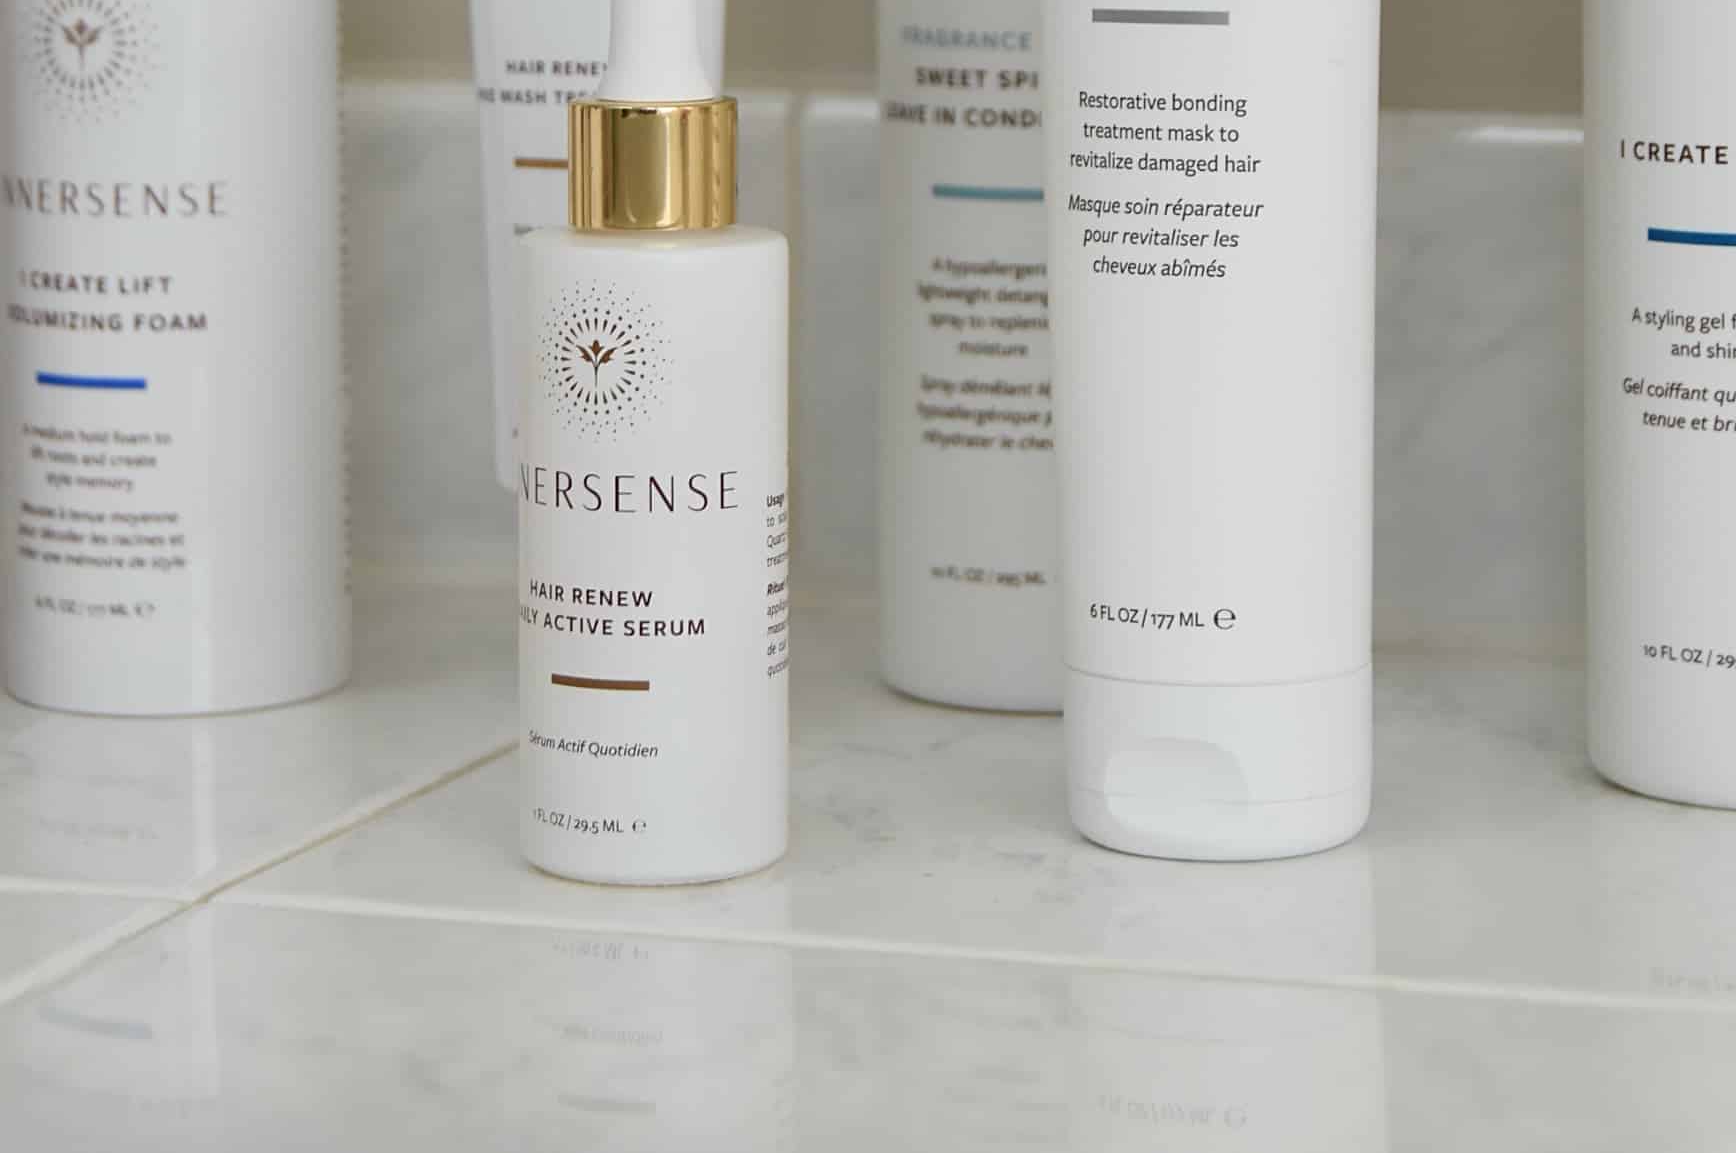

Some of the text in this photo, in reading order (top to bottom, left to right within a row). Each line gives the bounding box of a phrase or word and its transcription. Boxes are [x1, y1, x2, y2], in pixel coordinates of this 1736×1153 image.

[505, 59, 545, 76] HAIR
[915, 66, 987, 89] SWEET
[501, 89, 546, 104] WASH
[1079, 91, 1248, 118] Restorative bonding
[935, 106, 956, 125] IN
[1083, 122, 1240, 143] treatment mask to
[1069, 150, 1262, 177] revitalize damaged hair
[1619, 139, 1729, 165] I CREATE
[1068, 194, 1265, 222] Masque soin réparateur
[1083, 227, 1240, 248] pour revitaliser les
[1092, 255, 1227, 278] cheveux abîmés
[29, 270, 108, 295] CREATE
[118, 275, 172, 296] LIFT
[132, 310, 208, 332] FOAM
[1631, 306, 1641, 324] A
[1645, 310, 1696, 334] styling
[1699, 312, 1726, 335] gel
[1671, 341, 1702, 359] and
[1622, 377, 1645, 395] Gel
[1646, 382, 1708, 402] coiffant
[1643, 411, 1687, 430] tenue
[1691, 415, 1707, 431] et
[530, 577, 654, 608] HAIR RENEW
[543, 612, 614, 636] ACTIVE
[623, 618, 706, 637] SERUM
[1089, 603, 1098, 619] 6
[1100, 604, 1116, 622] FL
[1117, 607, 1139, 624] OZ
[1150, 613, 1175, 630] 177
[1179, 611, 1205, 628] ML
[1643, 644, 1658, 658] 10
[1660, 645, 1678, 662] FL
[1680, 648, 1703, 664] OZ
[557, 738, 586, 755] Actif
[587, 741, 659, 759] Quotidien
[549, 810, 565, 828] OZ
[573, 818, 600, 835] 29.5
[602, 818, 625, 834] ML
